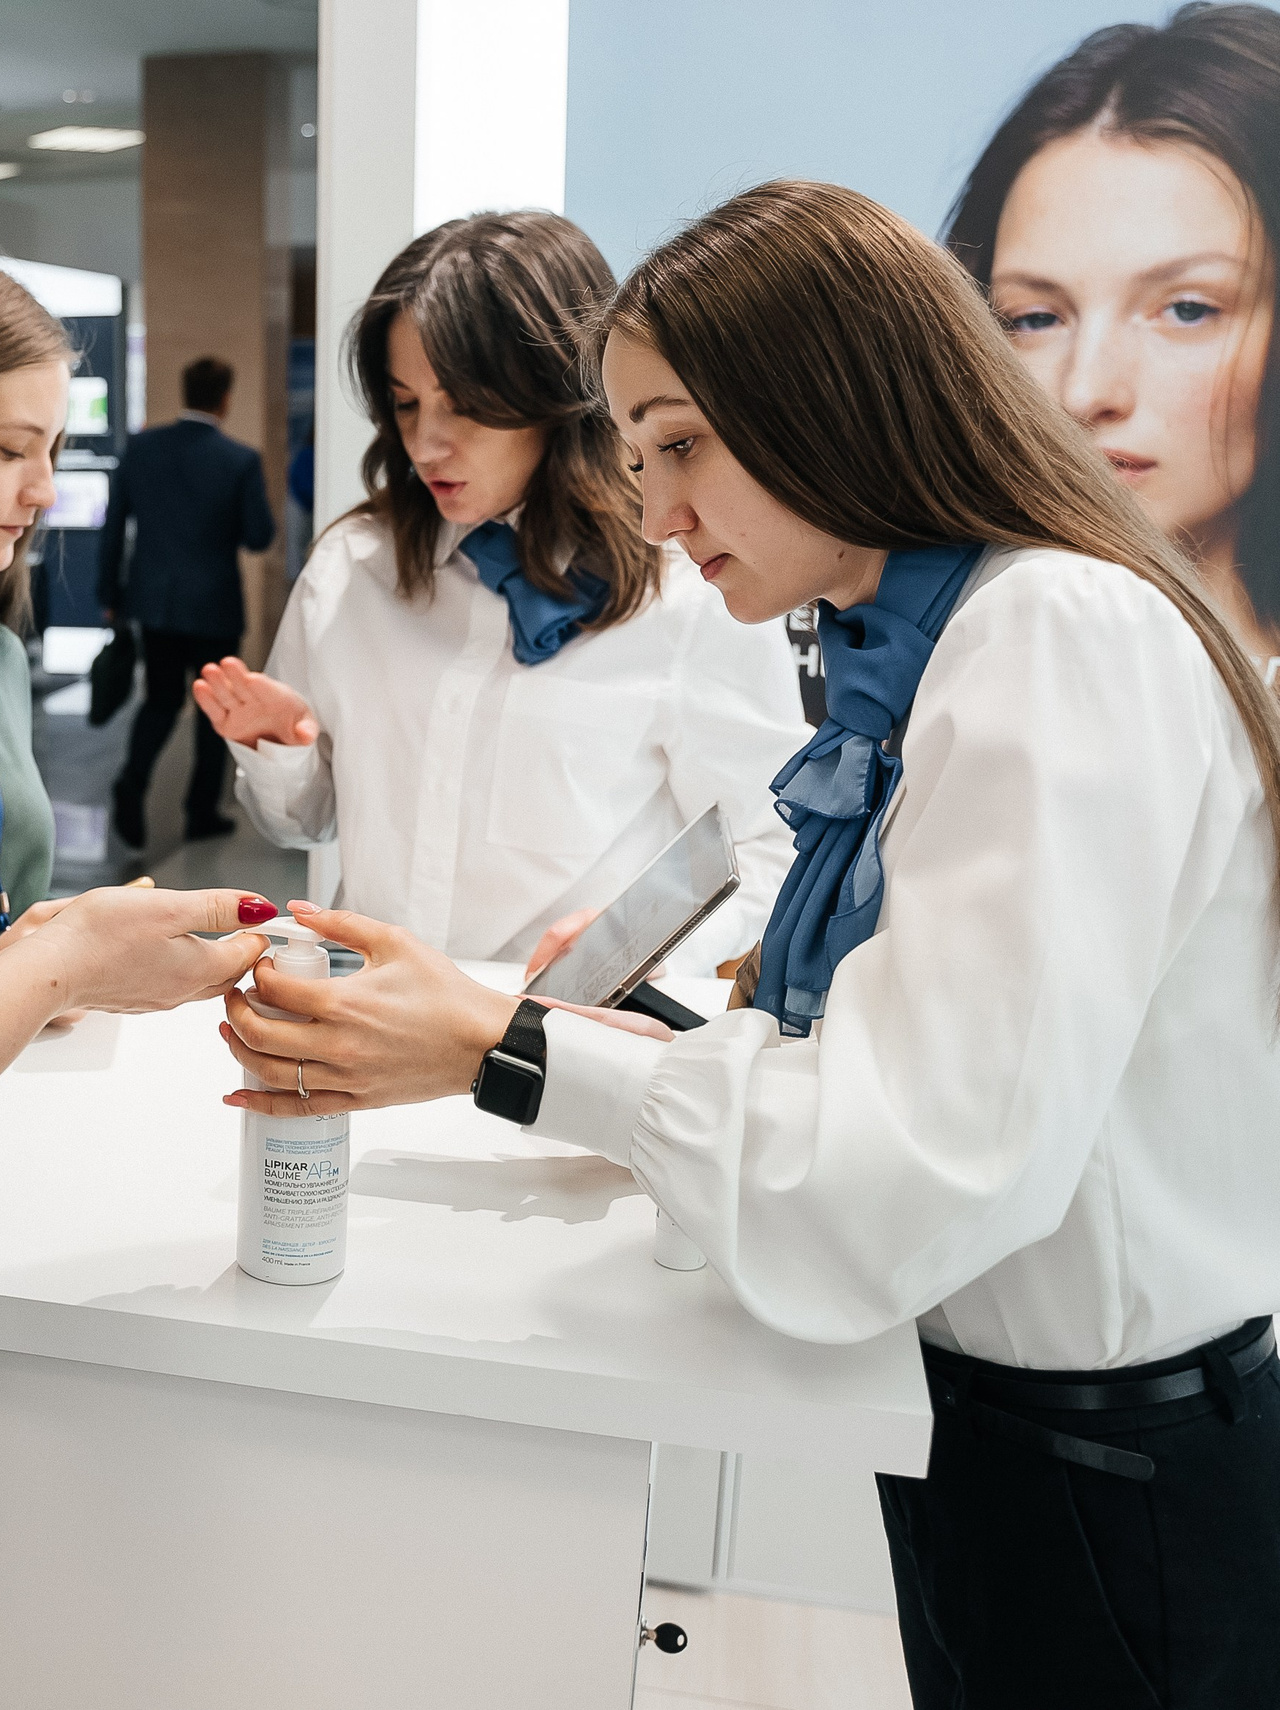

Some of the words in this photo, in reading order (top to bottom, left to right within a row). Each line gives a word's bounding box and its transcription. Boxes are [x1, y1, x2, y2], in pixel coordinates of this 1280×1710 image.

[264, 1158, 308, 1171] LIPIKAR
[264, 1168, 301, 1180] BAUME
[264, 1179, 306, 1188] МОМЕНТАЛЬНО
[264, 1187, 299, 1196] УСПОКАИВАЕТ
[263, 1195, 302, 1205] УМЕНЬШЕНИЮ
[263, 1206, 286, 1214] BAUME
[262, 1256, 274, 1264] 400
